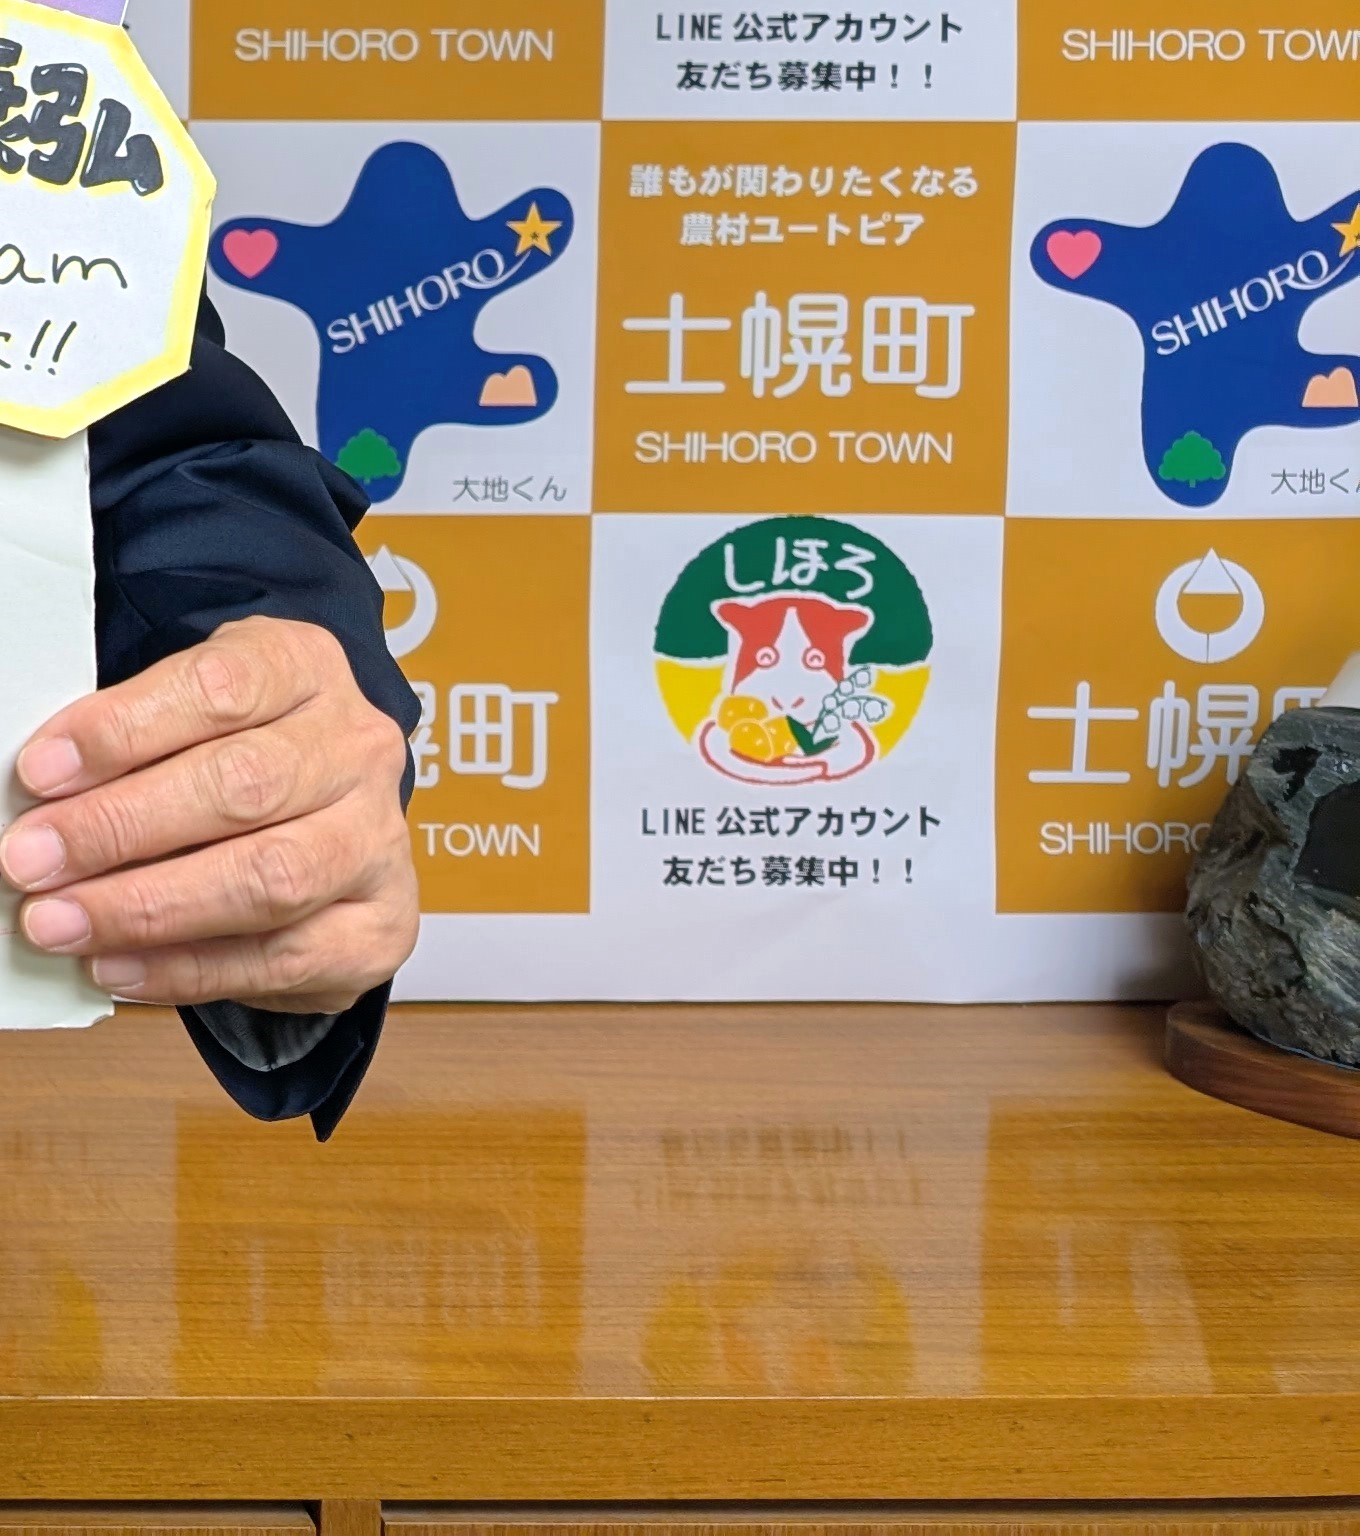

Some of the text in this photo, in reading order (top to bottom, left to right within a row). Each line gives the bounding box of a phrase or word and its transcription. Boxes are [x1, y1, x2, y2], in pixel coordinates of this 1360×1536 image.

[657, 13, 961, 42] LINE 公式アカウント
[235, 29, 553, 61] SHIHORO TOWN
[1062, 29, 1245, 60] SHIHORO
[677, 62, 931, 90] 友だち募集中！！
[630, 164, 978, 197] 誰もが関わりたくなる
[680, 212, 924, 246] 農村ユートピア
[327, 247, 505, 356] SHIHORO
[1151, 249, 1330, 357] SHIHORO
[623, 291, 975, 398] 士幌町
[635, 431, 953, 463] SHIHORO TOWN
[453, 476, 566, 502] 大地くん
[1271, 468, 1360, 494] 大地く
[722, 536, 876, 600] しほろ
[1026, 678, 1330, 788] 士幌
[643, 807, 940, 836] LINE 公式アカウント
[418, 823, 540, 856] TOWN
[664, 856, 912, 886] 友だち募集中！！
